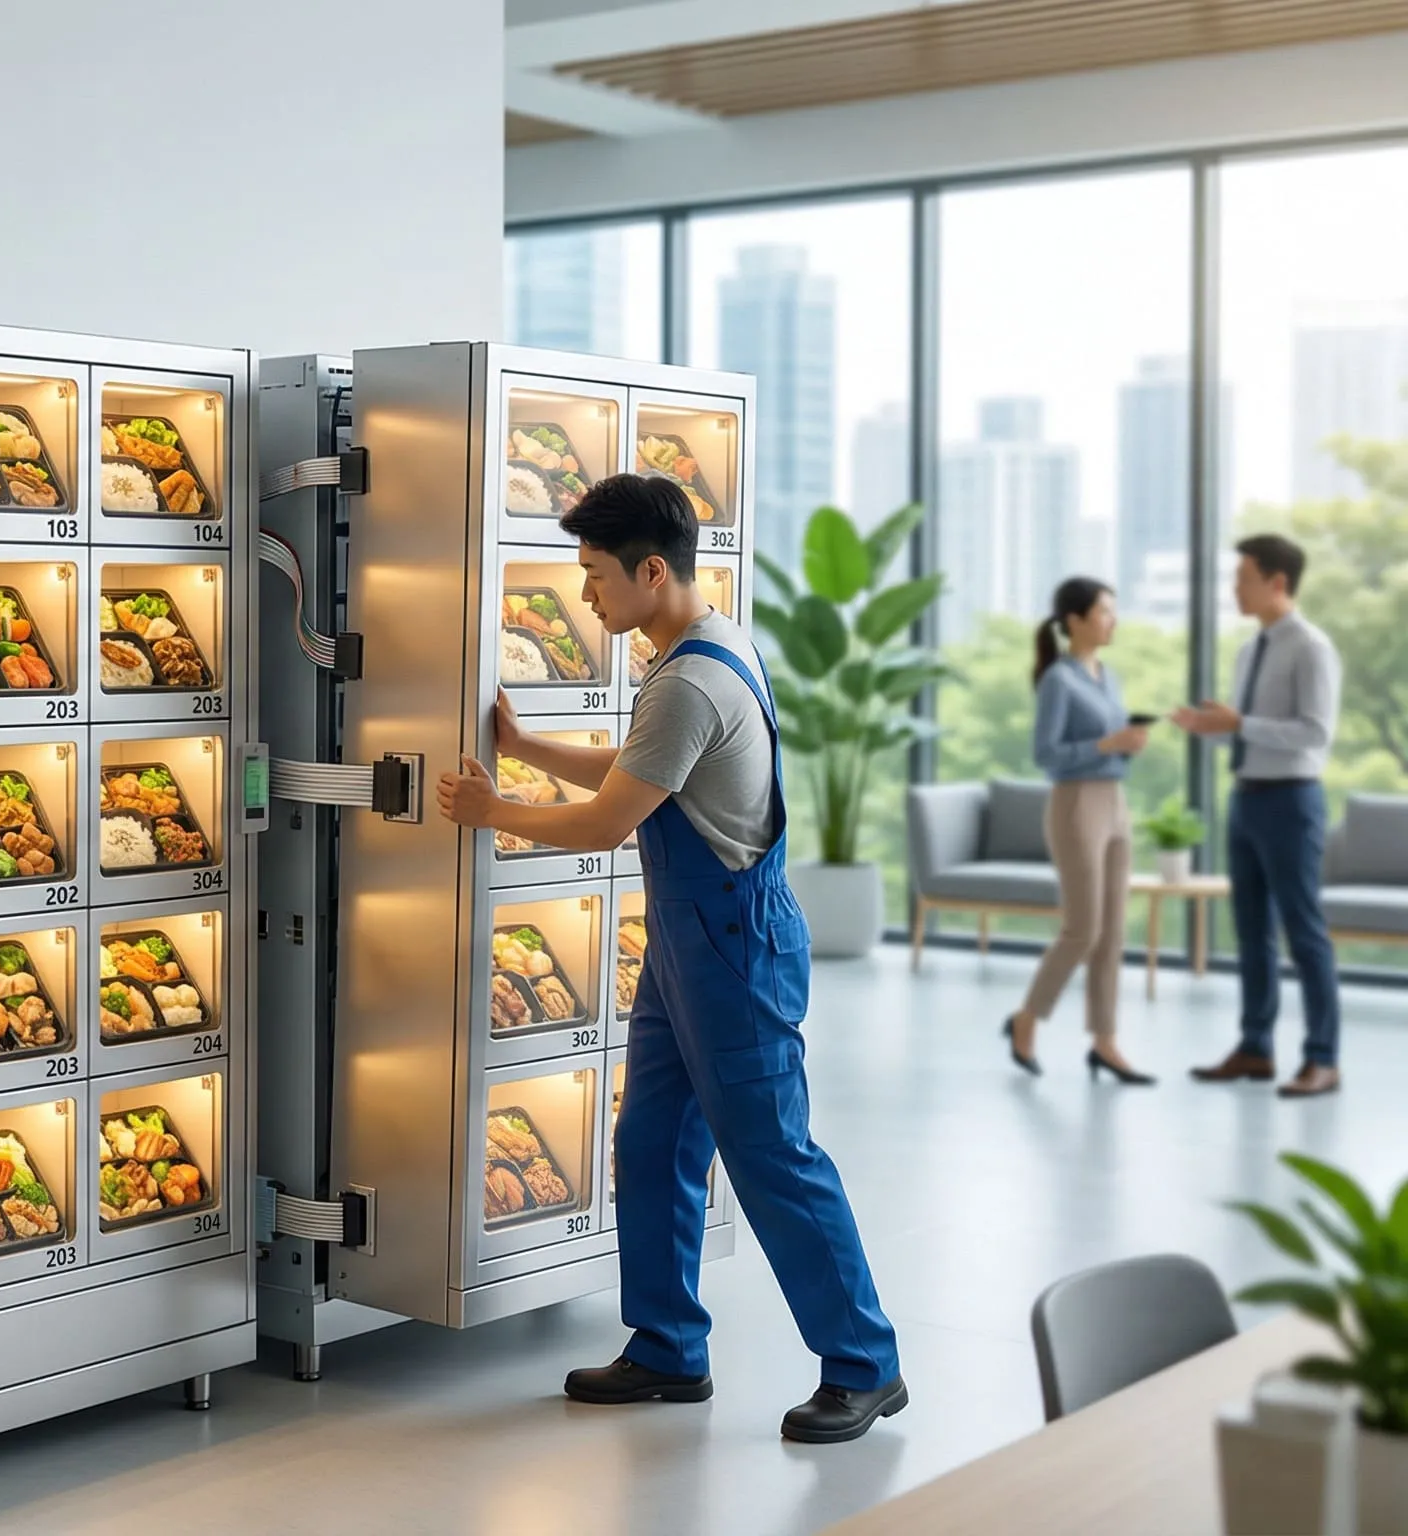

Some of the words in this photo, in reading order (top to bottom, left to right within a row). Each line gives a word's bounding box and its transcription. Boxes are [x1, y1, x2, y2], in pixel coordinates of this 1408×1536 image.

[48, 520, 78, 539] 103
[194, 525, 224, 543] 104
[712, 531, 735, 548] 302
[193, 696, 223, 714] 203
[583, 692, 607, 709] 301
[47, 701, 79, 720] 203
[577, 857, 601, 876] 301
[193, 870, 224, 891] 304
[46, 886, 79, 906] 202
[193, 1034, 223, 1055] 204
[572, 1030, 599, 1048] 302
[46, 1057, 79, 1078] 203
[194, 1213, 221, 1235] 304
[47, 1247, 77, 1269] 203
